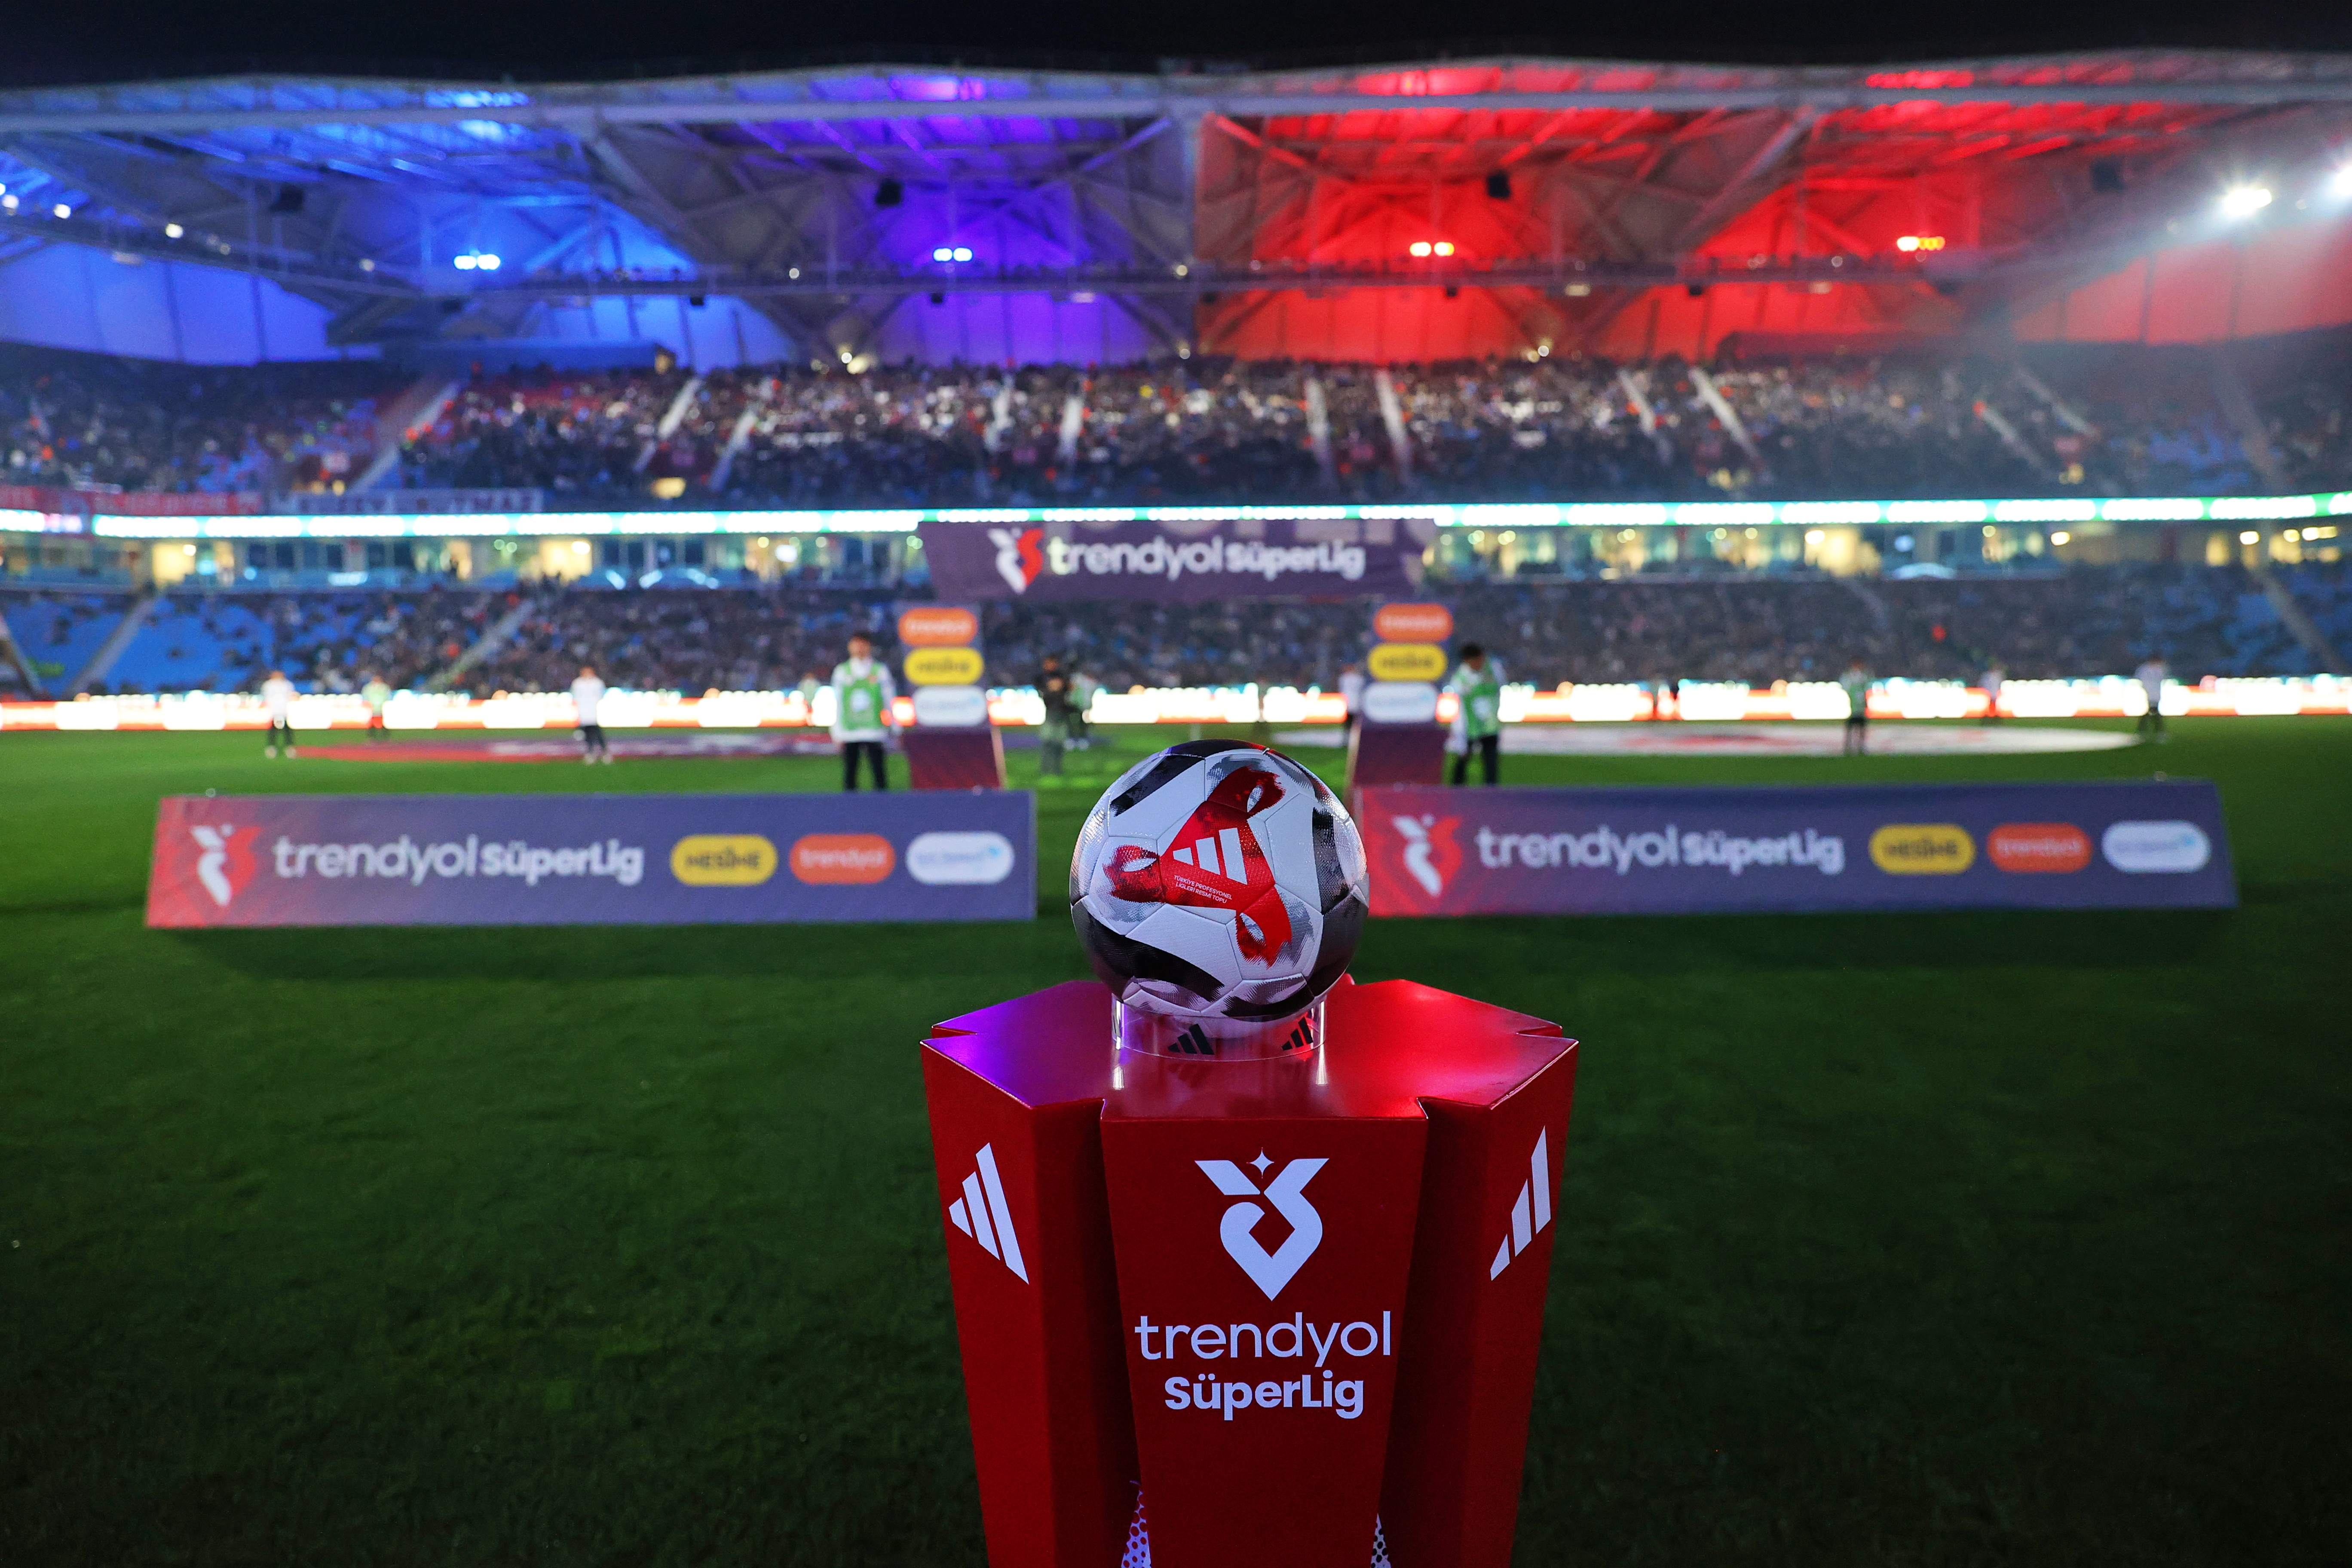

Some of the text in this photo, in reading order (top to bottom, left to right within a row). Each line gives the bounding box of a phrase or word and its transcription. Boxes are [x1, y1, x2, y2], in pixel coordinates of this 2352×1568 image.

[1048, 535, 1222, 581] trendyol
[272, 834, 478, 886] trendyol
[1475, 825, 1678, 875] trendyol
[1195, 883, 1232, 900] PROFESYONEL
[1213, 895, 1227, 903] TOPU
[1134, 1311, 1390, 1367] trendyol
[1164, 1369, 1363, 1421] SüperLig
